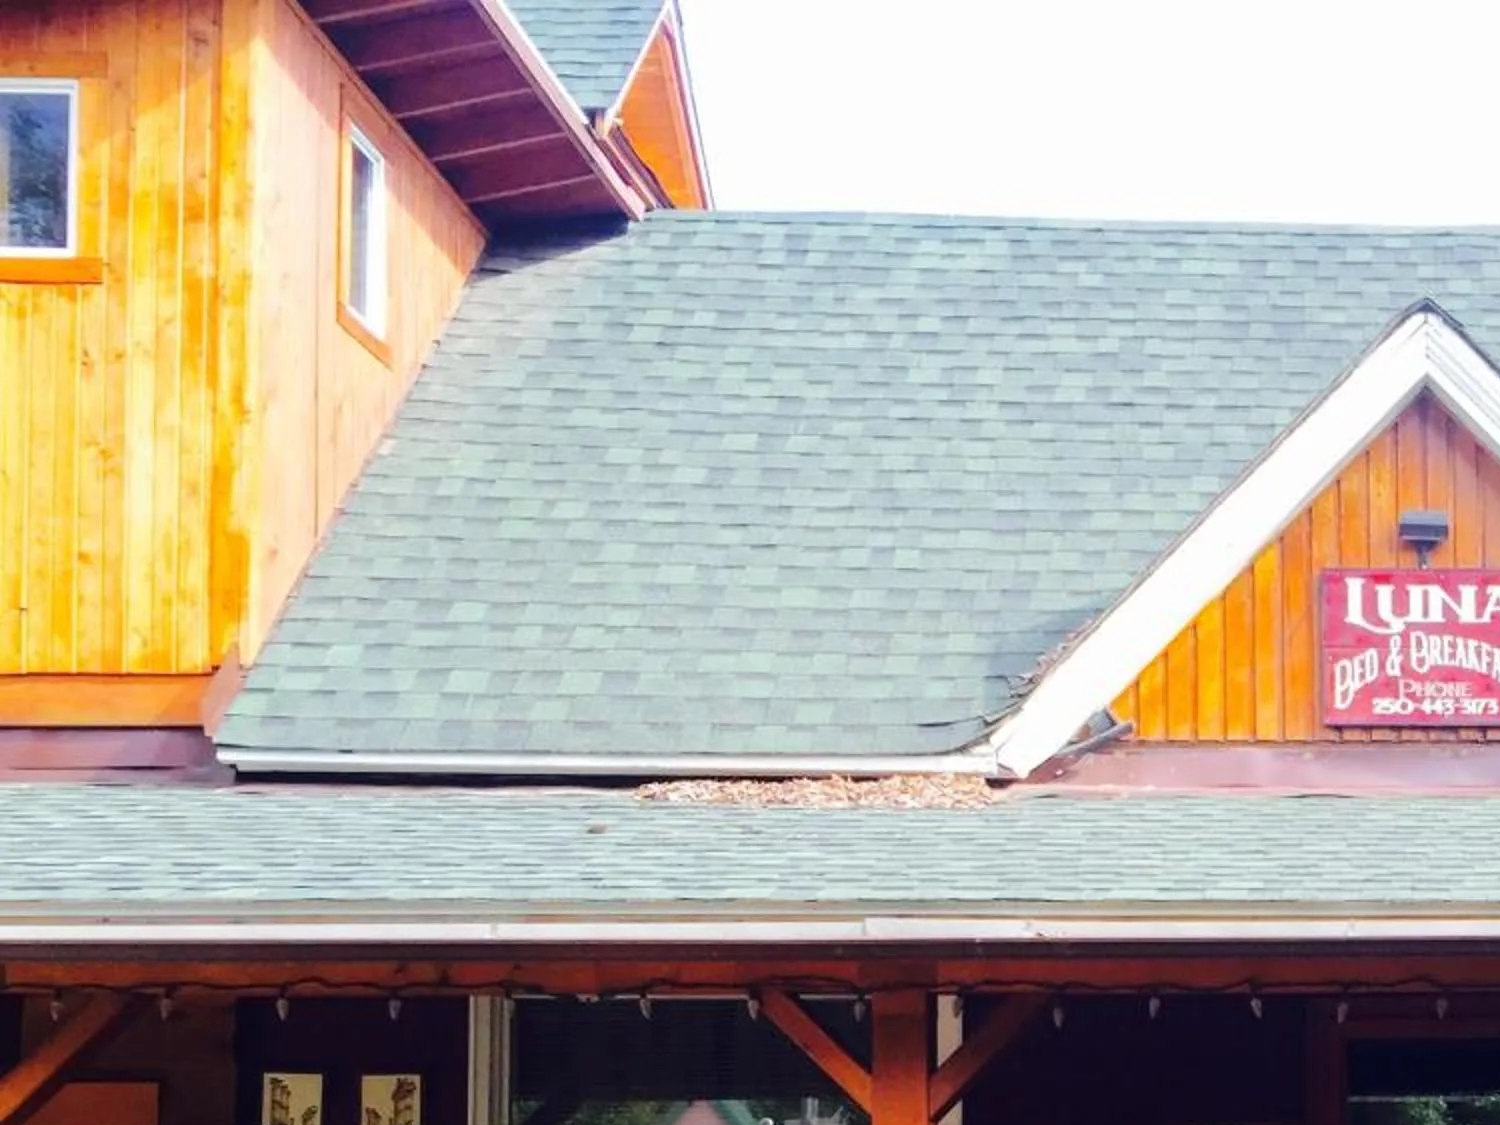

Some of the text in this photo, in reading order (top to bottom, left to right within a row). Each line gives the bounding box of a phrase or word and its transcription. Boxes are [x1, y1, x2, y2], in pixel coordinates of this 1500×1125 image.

[1333, 647, 1379, 710] BED
[1385, 635, 1402, 677] &
[1398, 679, 1473, 698] PHONE
